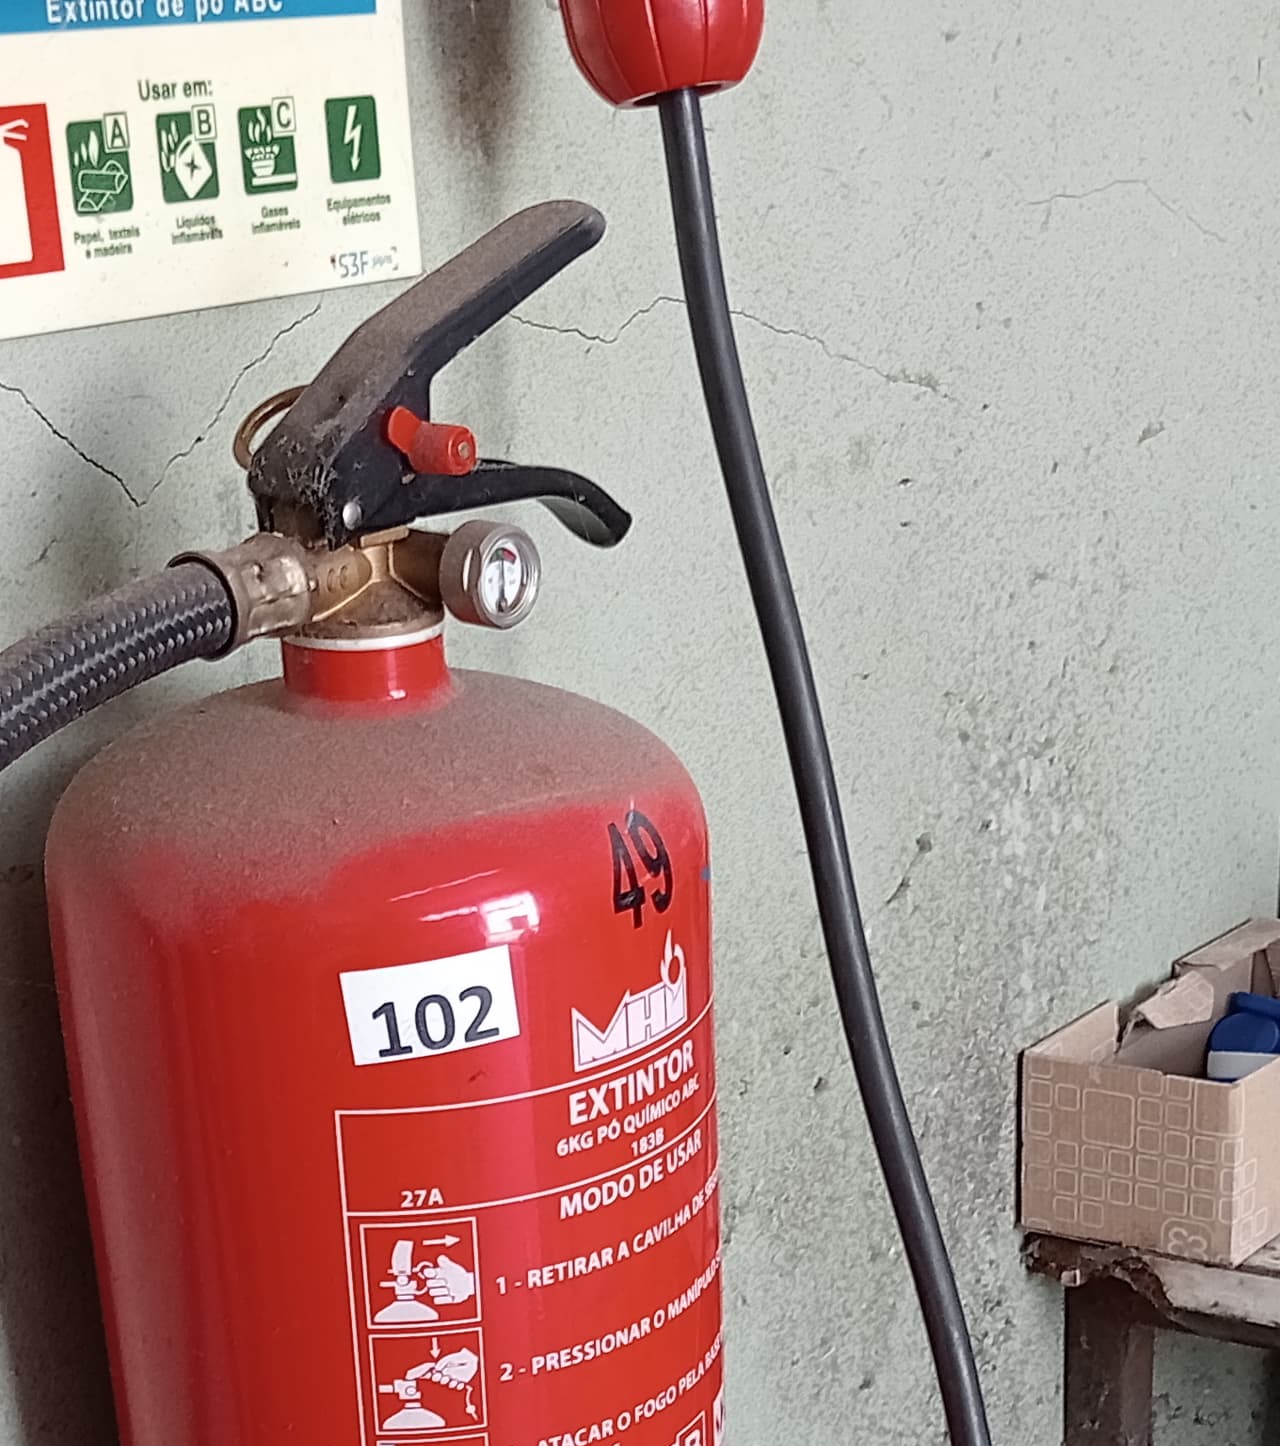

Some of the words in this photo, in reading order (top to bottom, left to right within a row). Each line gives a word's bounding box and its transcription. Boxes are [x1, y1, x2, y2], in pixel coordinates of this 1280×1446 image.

[46, 0, 144, 23] Extintor
[111, 118, 126, 149] A
[197, 110, 211, 135] B
[277, 101, 291, 128] C
[137, 79, 177, 101] Usar
[183, 80, 213, 98] em:
[607, 807, 673, 930] 49
[372, 985, 500, 1059] 102
[556, 1130, 593, 1157] 6KG
[597, 1118, 621, 1145] PÓ
[623, 1089, 680, 1134] QUÍMICO
[681, 1072, 699, 1101] ABC
[569, 1039, 694, 1126] EXTINTOR
[559, 1173, 635, 1220] MODO
[639, 1157, 664, 1190] DE
[666, 1128, 702, 1173] USAR
[631, 1127, 664, 1157] 183B
[401, 1189, 444, 1209] 27A
[496, 1276, 506, 1295] 1
[526, 1243, 614, 1290] RETIRAR
[617, 1240, 631, 1260] A
[632, 1208, 691, 1253] CAVILHA
[500, 1363, 513, 1382] 2
[531, 1319, 651, 1375] PRESSIONAR
[653, 1310, 665, 1328] O
[617, 1412, 632, 1431] O
[634, 1389, 676, 1424] FOGO
[678, 1361, 705, 1396] PELA
